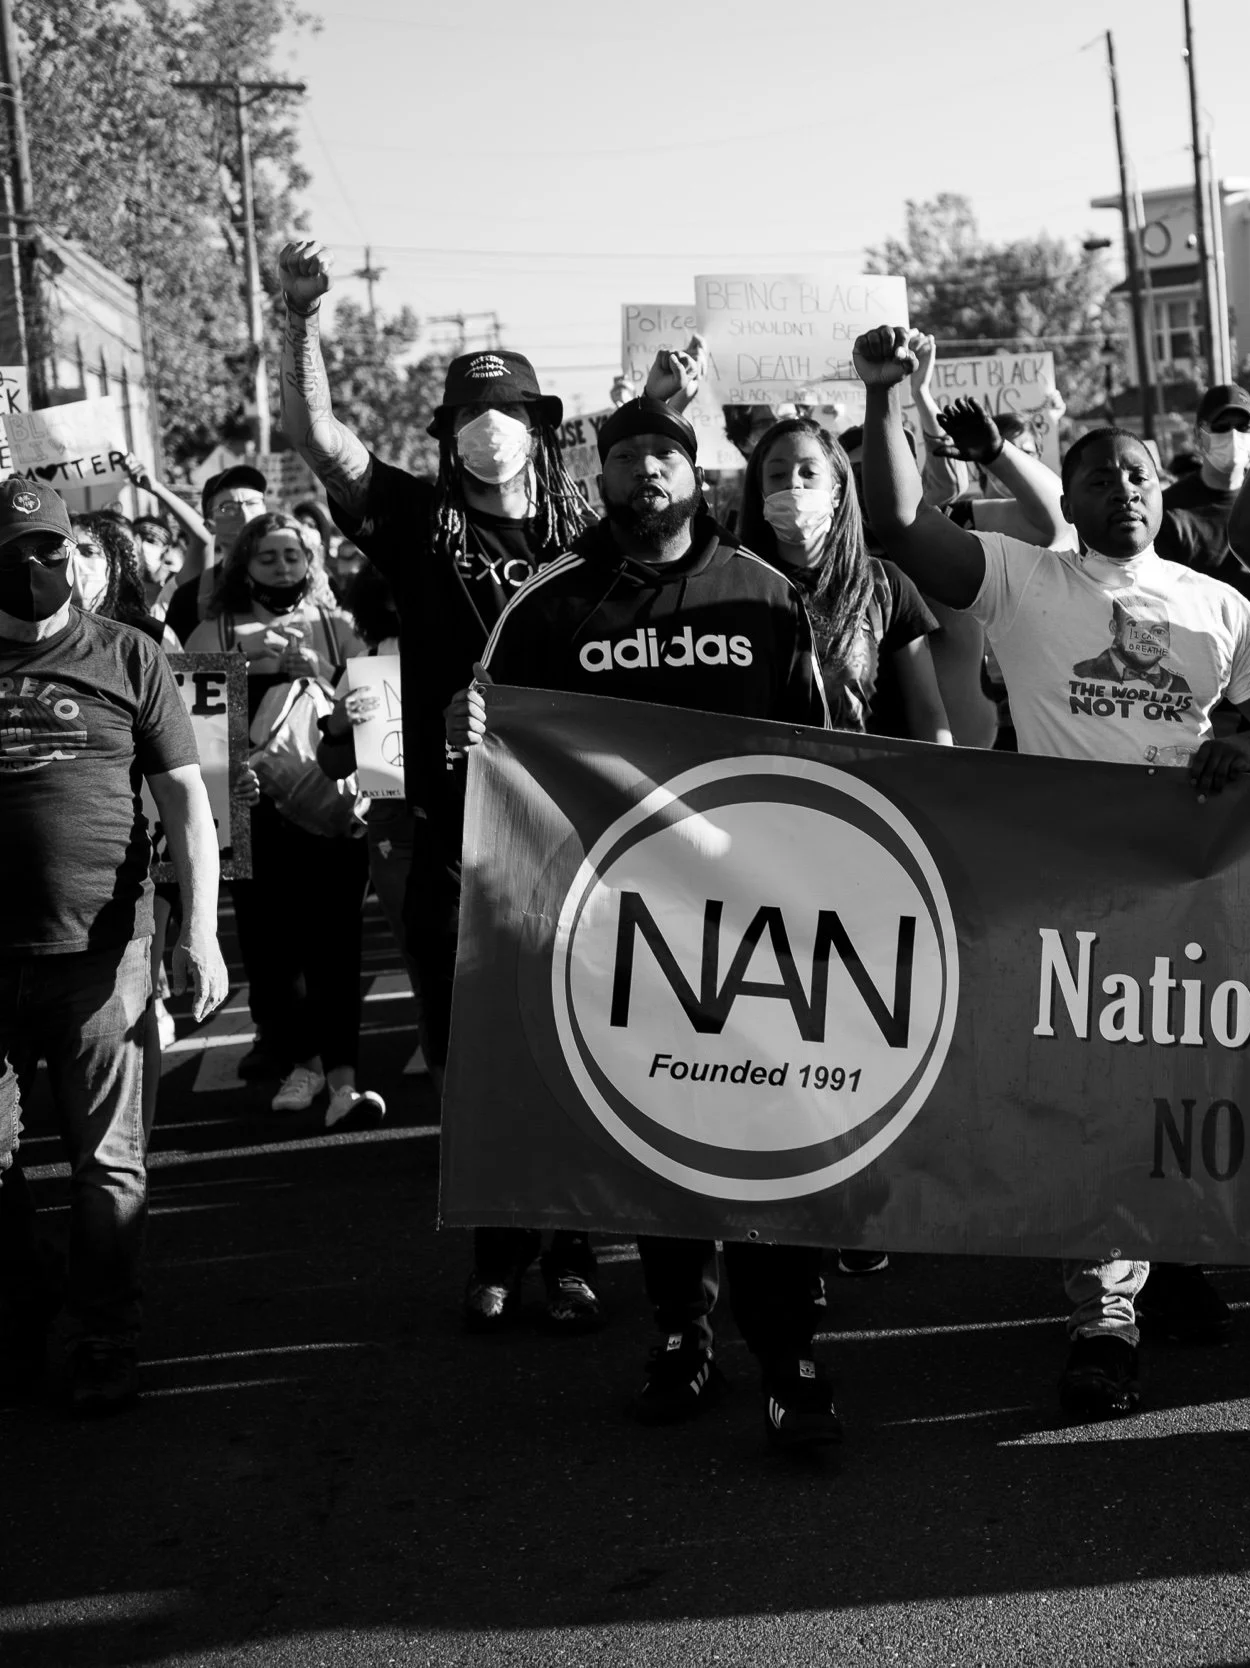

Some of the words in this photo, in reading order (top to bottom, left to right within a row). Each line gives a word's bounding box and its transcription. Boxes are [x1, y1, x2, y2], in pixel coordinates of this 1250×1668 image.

[705, 281, 788, 312] BEING
[799, 282, 887, 315] BLACK
[626, 306, 697, 341] Police
[737, 353, 812, 384] DEATH
[987, 359, 1047, 388] BLACK
[579, 625, 753, 673] adidas
[1128, 643, 1169, 657] BREATHE
[1068, 680, 1106, 698] THE
[1111, 685, 1173, 704] WORLD
[1174, 694, 1193, 711] IS
[1068, 696, 1135, 719] NOT
[1143, 702, 1184, 723] OK
[610, 891, 917, 1050] NAN
[648, 1053, 789, 1087] Founded
[799, 1064, 863, 1093] 1991
[1150, 1097, 1246, 1183] NO
